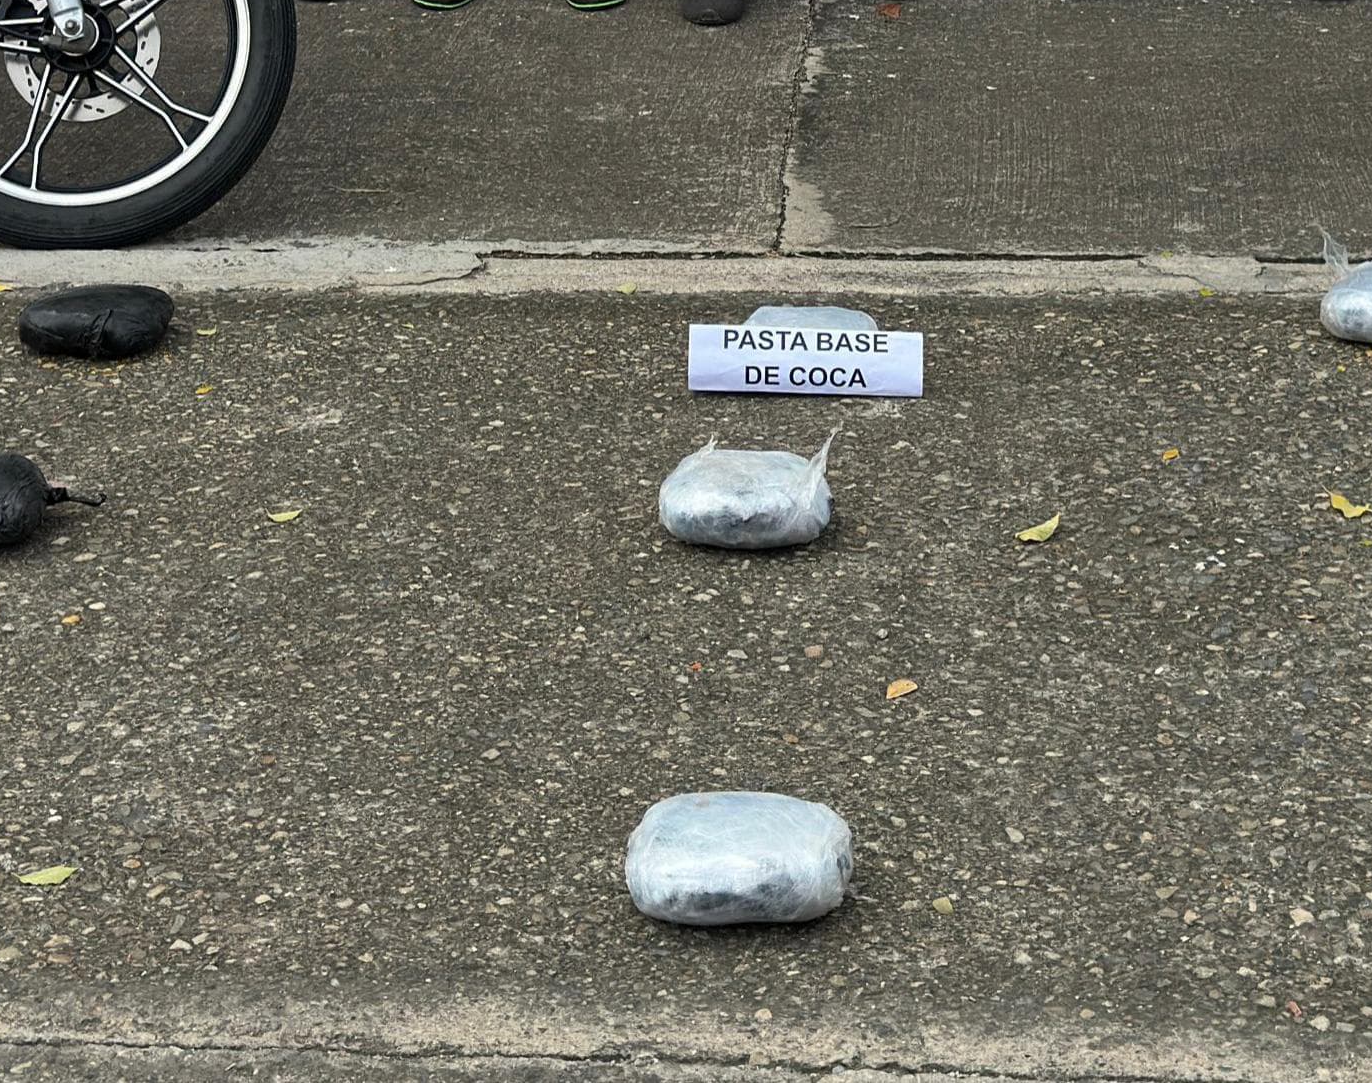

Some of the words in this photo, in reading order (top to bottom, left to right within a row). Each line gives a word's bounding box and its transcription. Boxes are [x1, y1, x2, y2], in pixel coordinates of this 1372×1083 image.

[723, 329, 808, 351] PASTA
[817, 332, 889, 353] BASE
[745, 366, 780, 386] DE
[789, 367, 867, 389] COCA
